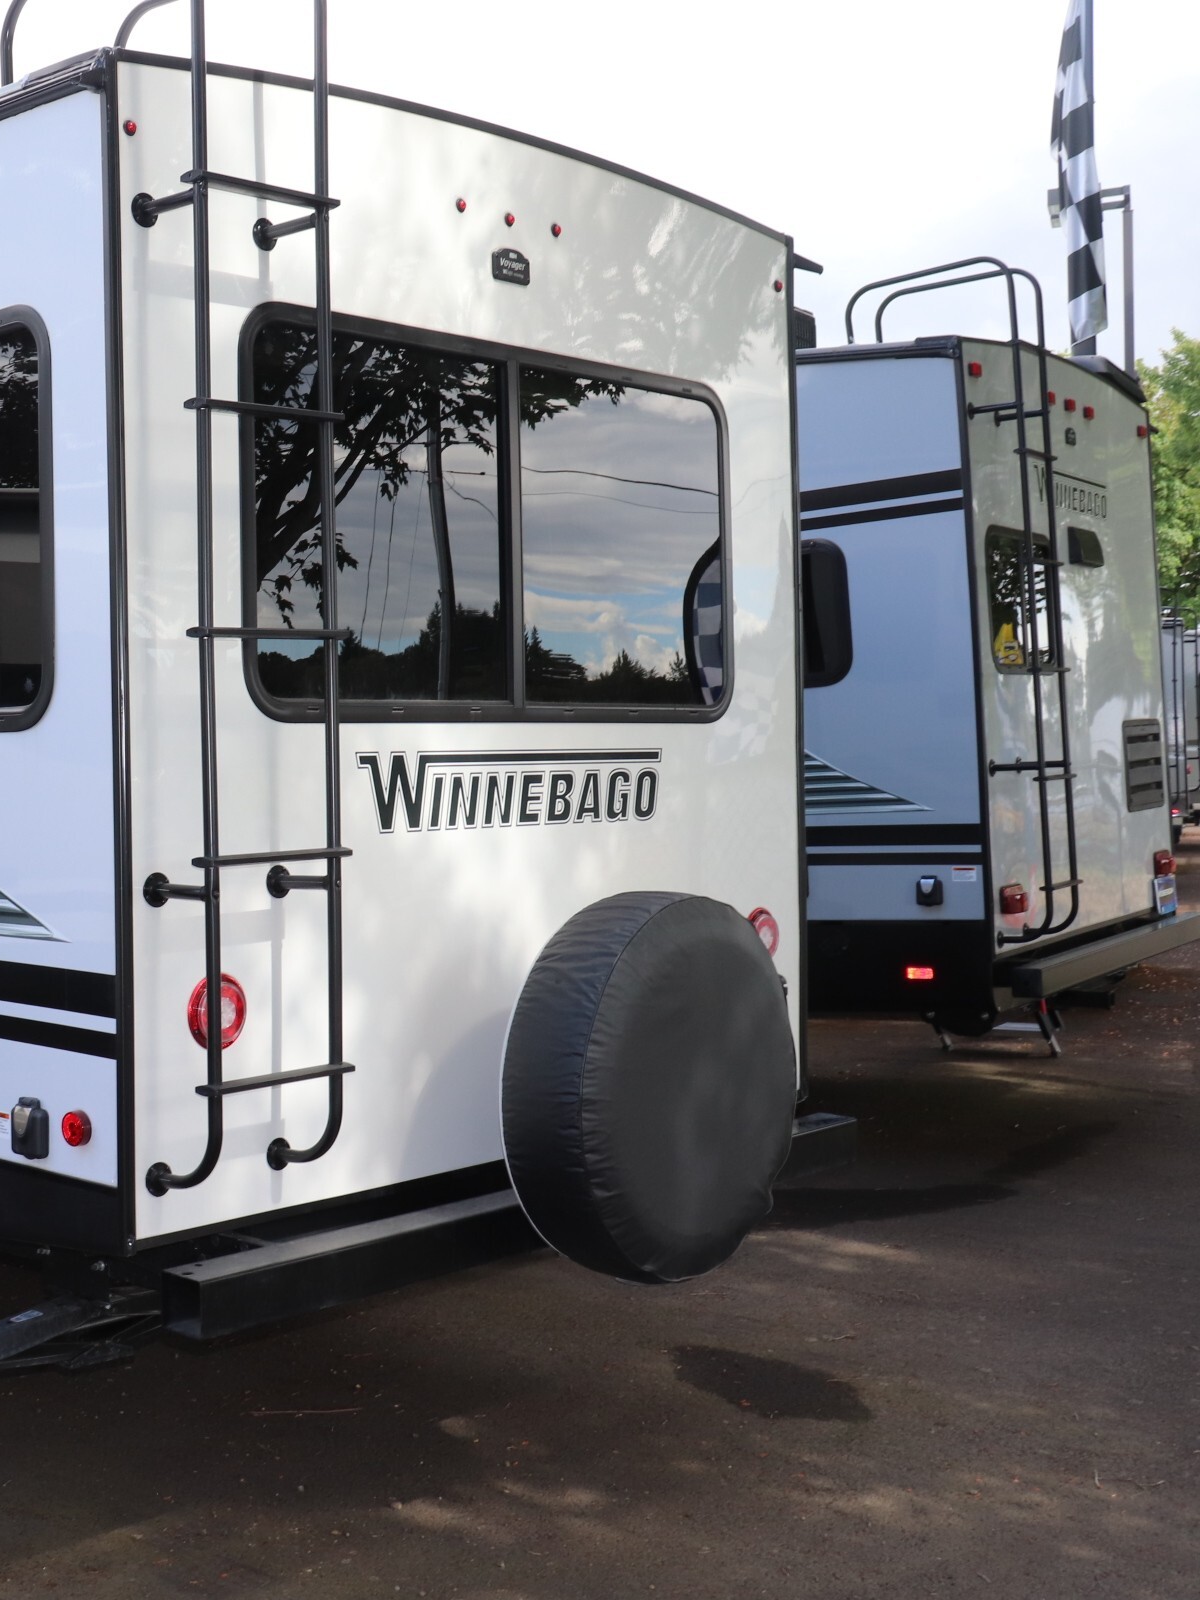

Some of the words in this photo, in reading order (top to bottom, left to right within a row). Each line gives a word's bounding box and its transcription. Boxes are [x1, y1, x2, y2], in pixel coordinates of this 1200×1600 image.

[500, 257, 526, 271] Voyager
[1033, 464, 1107, 519] WNNEBAGO
[355, 748, 662, 834] WINNEBAGO
